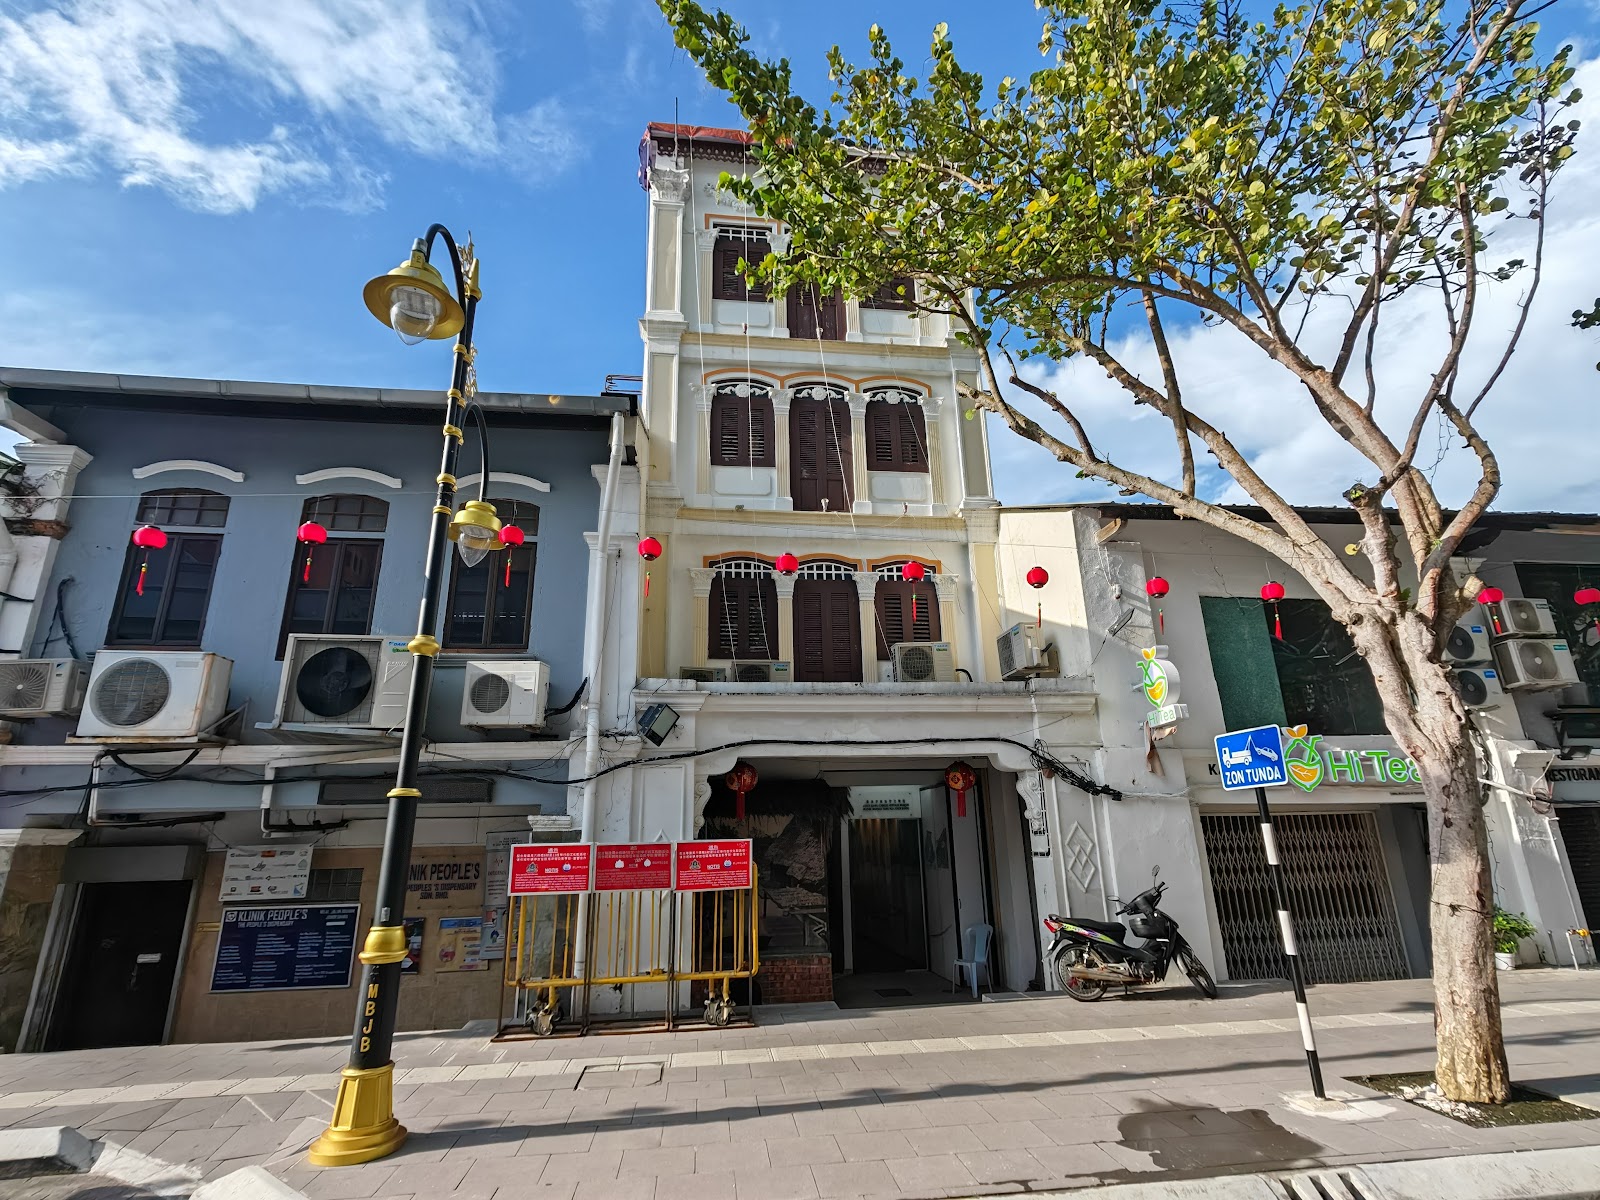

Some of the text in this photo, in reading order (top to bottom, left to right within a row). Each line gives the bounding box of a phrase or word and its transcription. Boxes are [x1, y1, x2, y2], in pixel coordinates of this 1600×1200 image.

[1148, 709, 1176, 726] Hi Tea
[1328, 750, 1364, 783] Hi
[1225, 767, 1282, 785] ZON TUNDA
[430, 863, 480, 880] PEOPLE'S
[440, 883, 477, 891] DISPENSARY
[238, 911, 265, 922] KLINIK
[267, 909, 308, 921] PEOPLE'S
[360, 983, 379, 1052] MBJB
